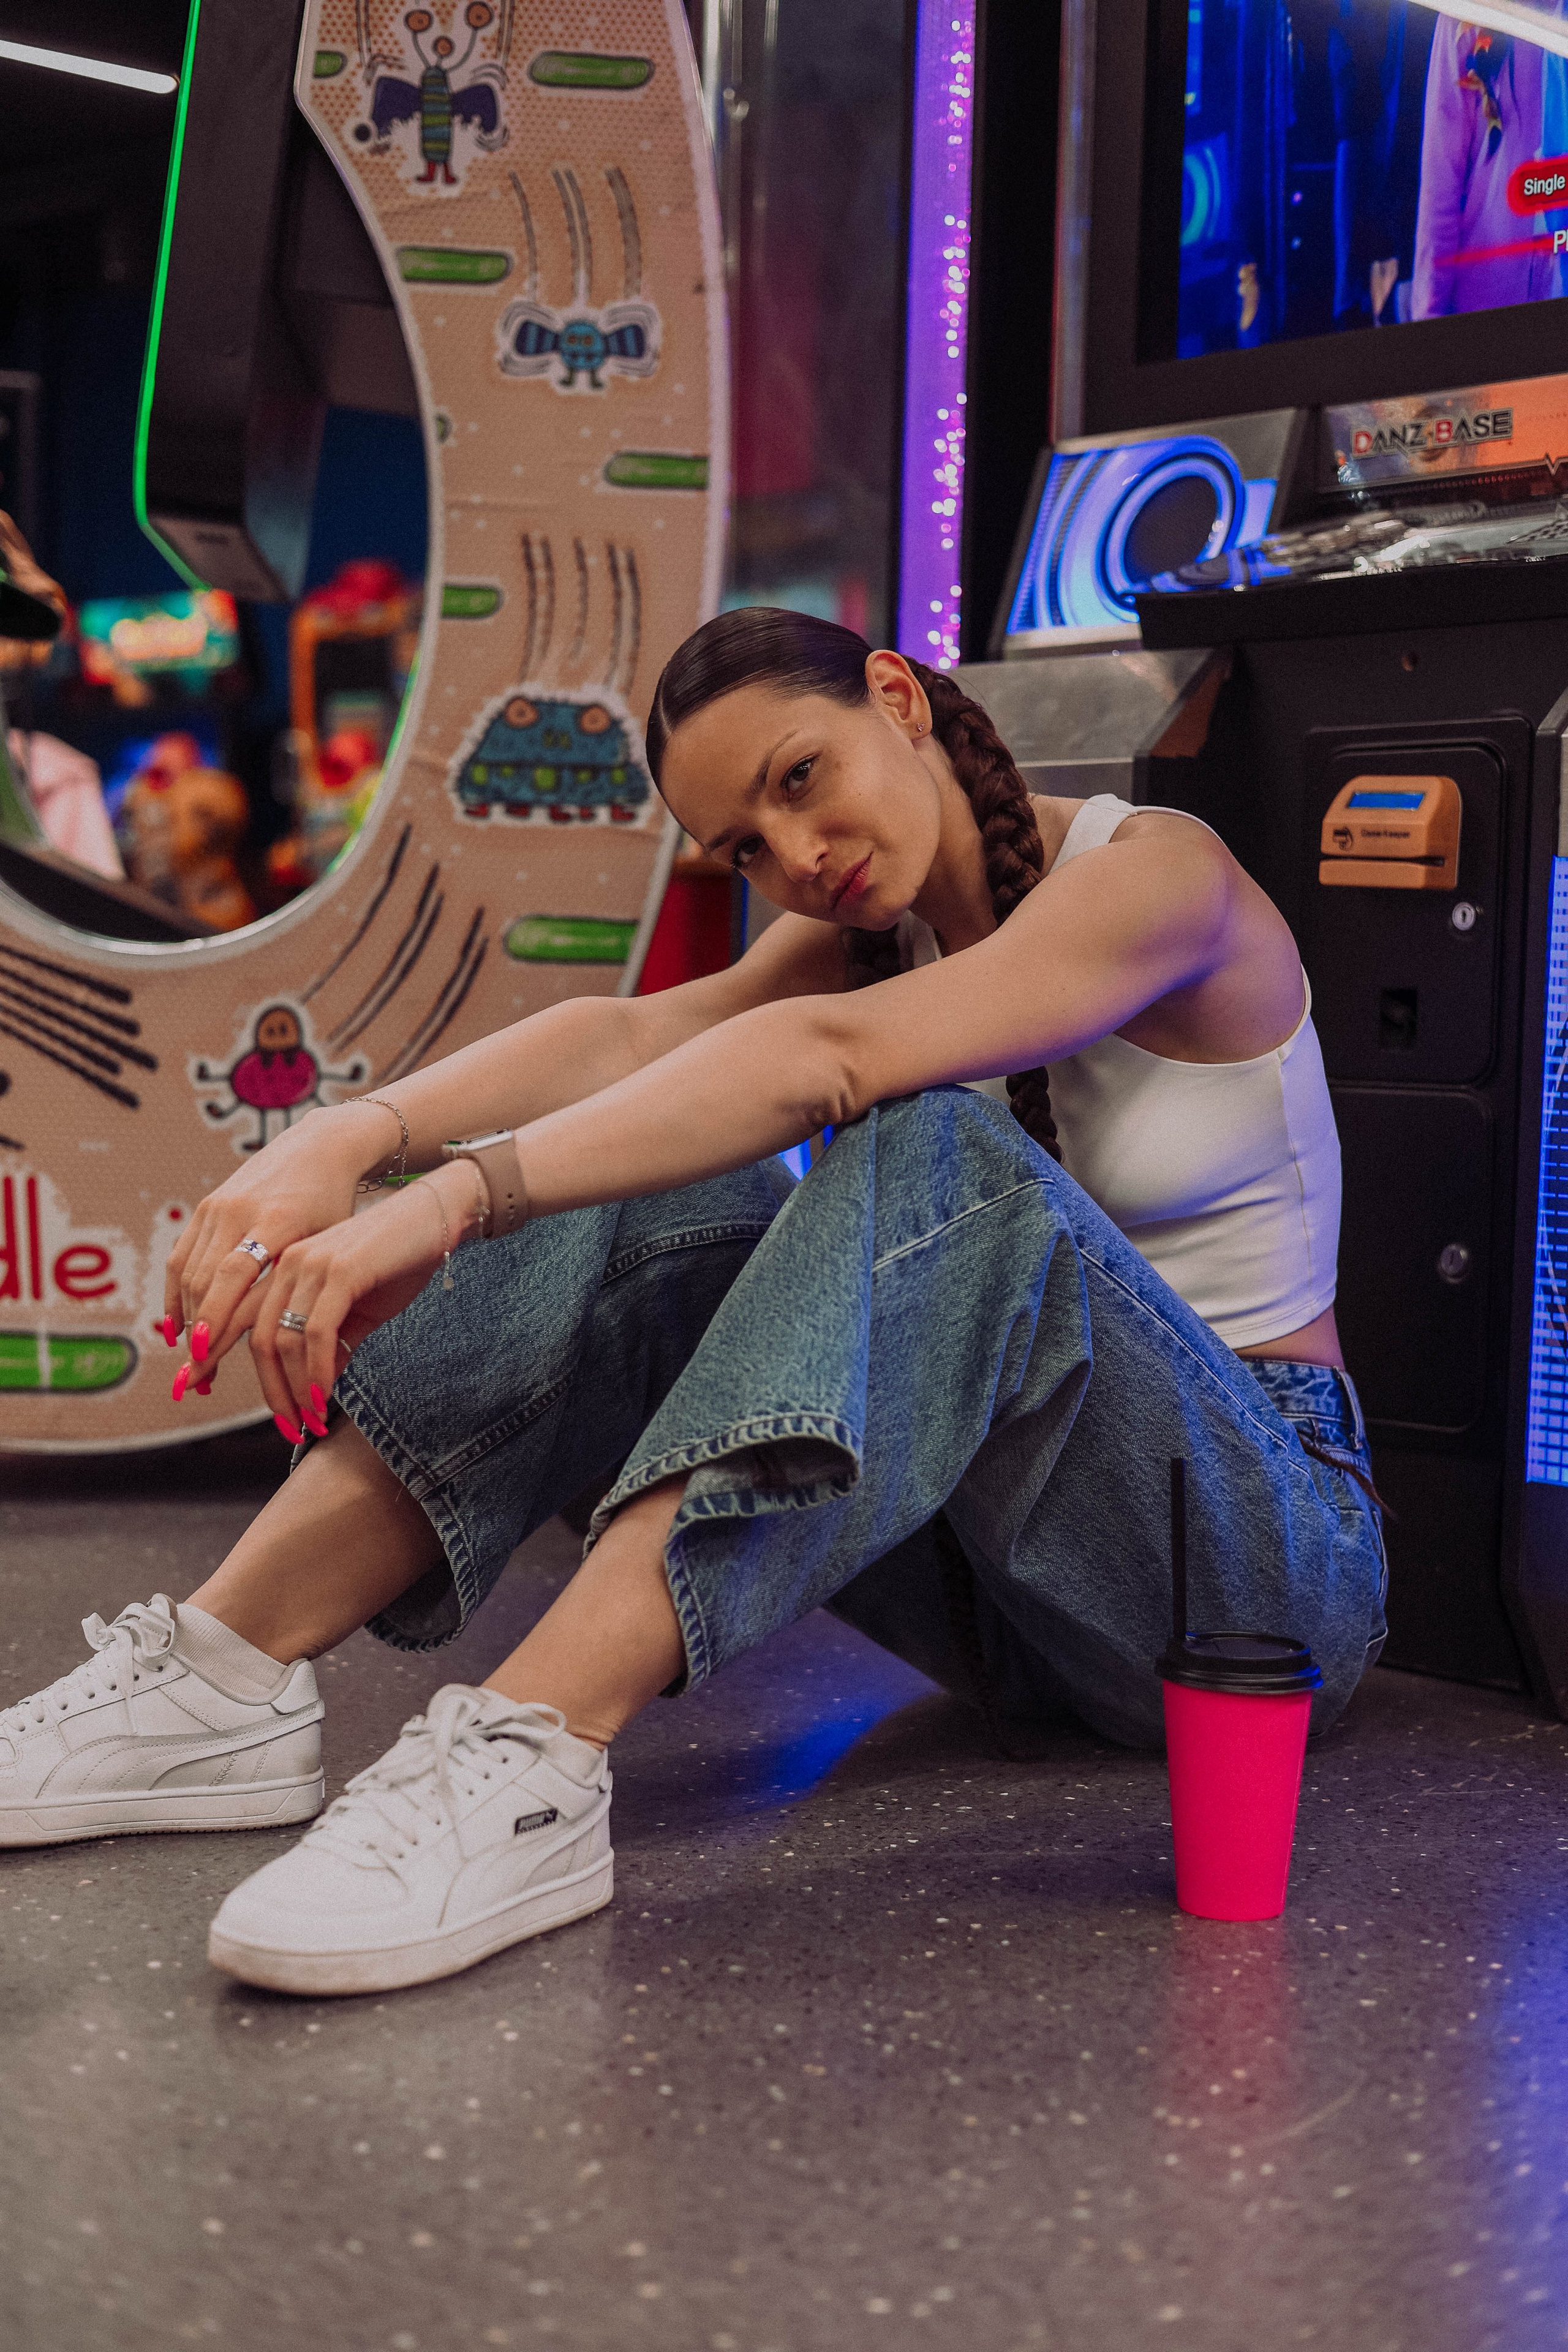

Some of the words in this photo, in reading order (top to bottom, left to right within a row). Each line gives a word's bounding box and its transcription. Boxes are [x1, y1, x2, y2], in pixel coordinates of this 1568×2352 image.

[1523, 173, 1566, 196] Single
[1353, 423, 1427, 455] DANZ
[1435, 410, 1510, 443] BASE
